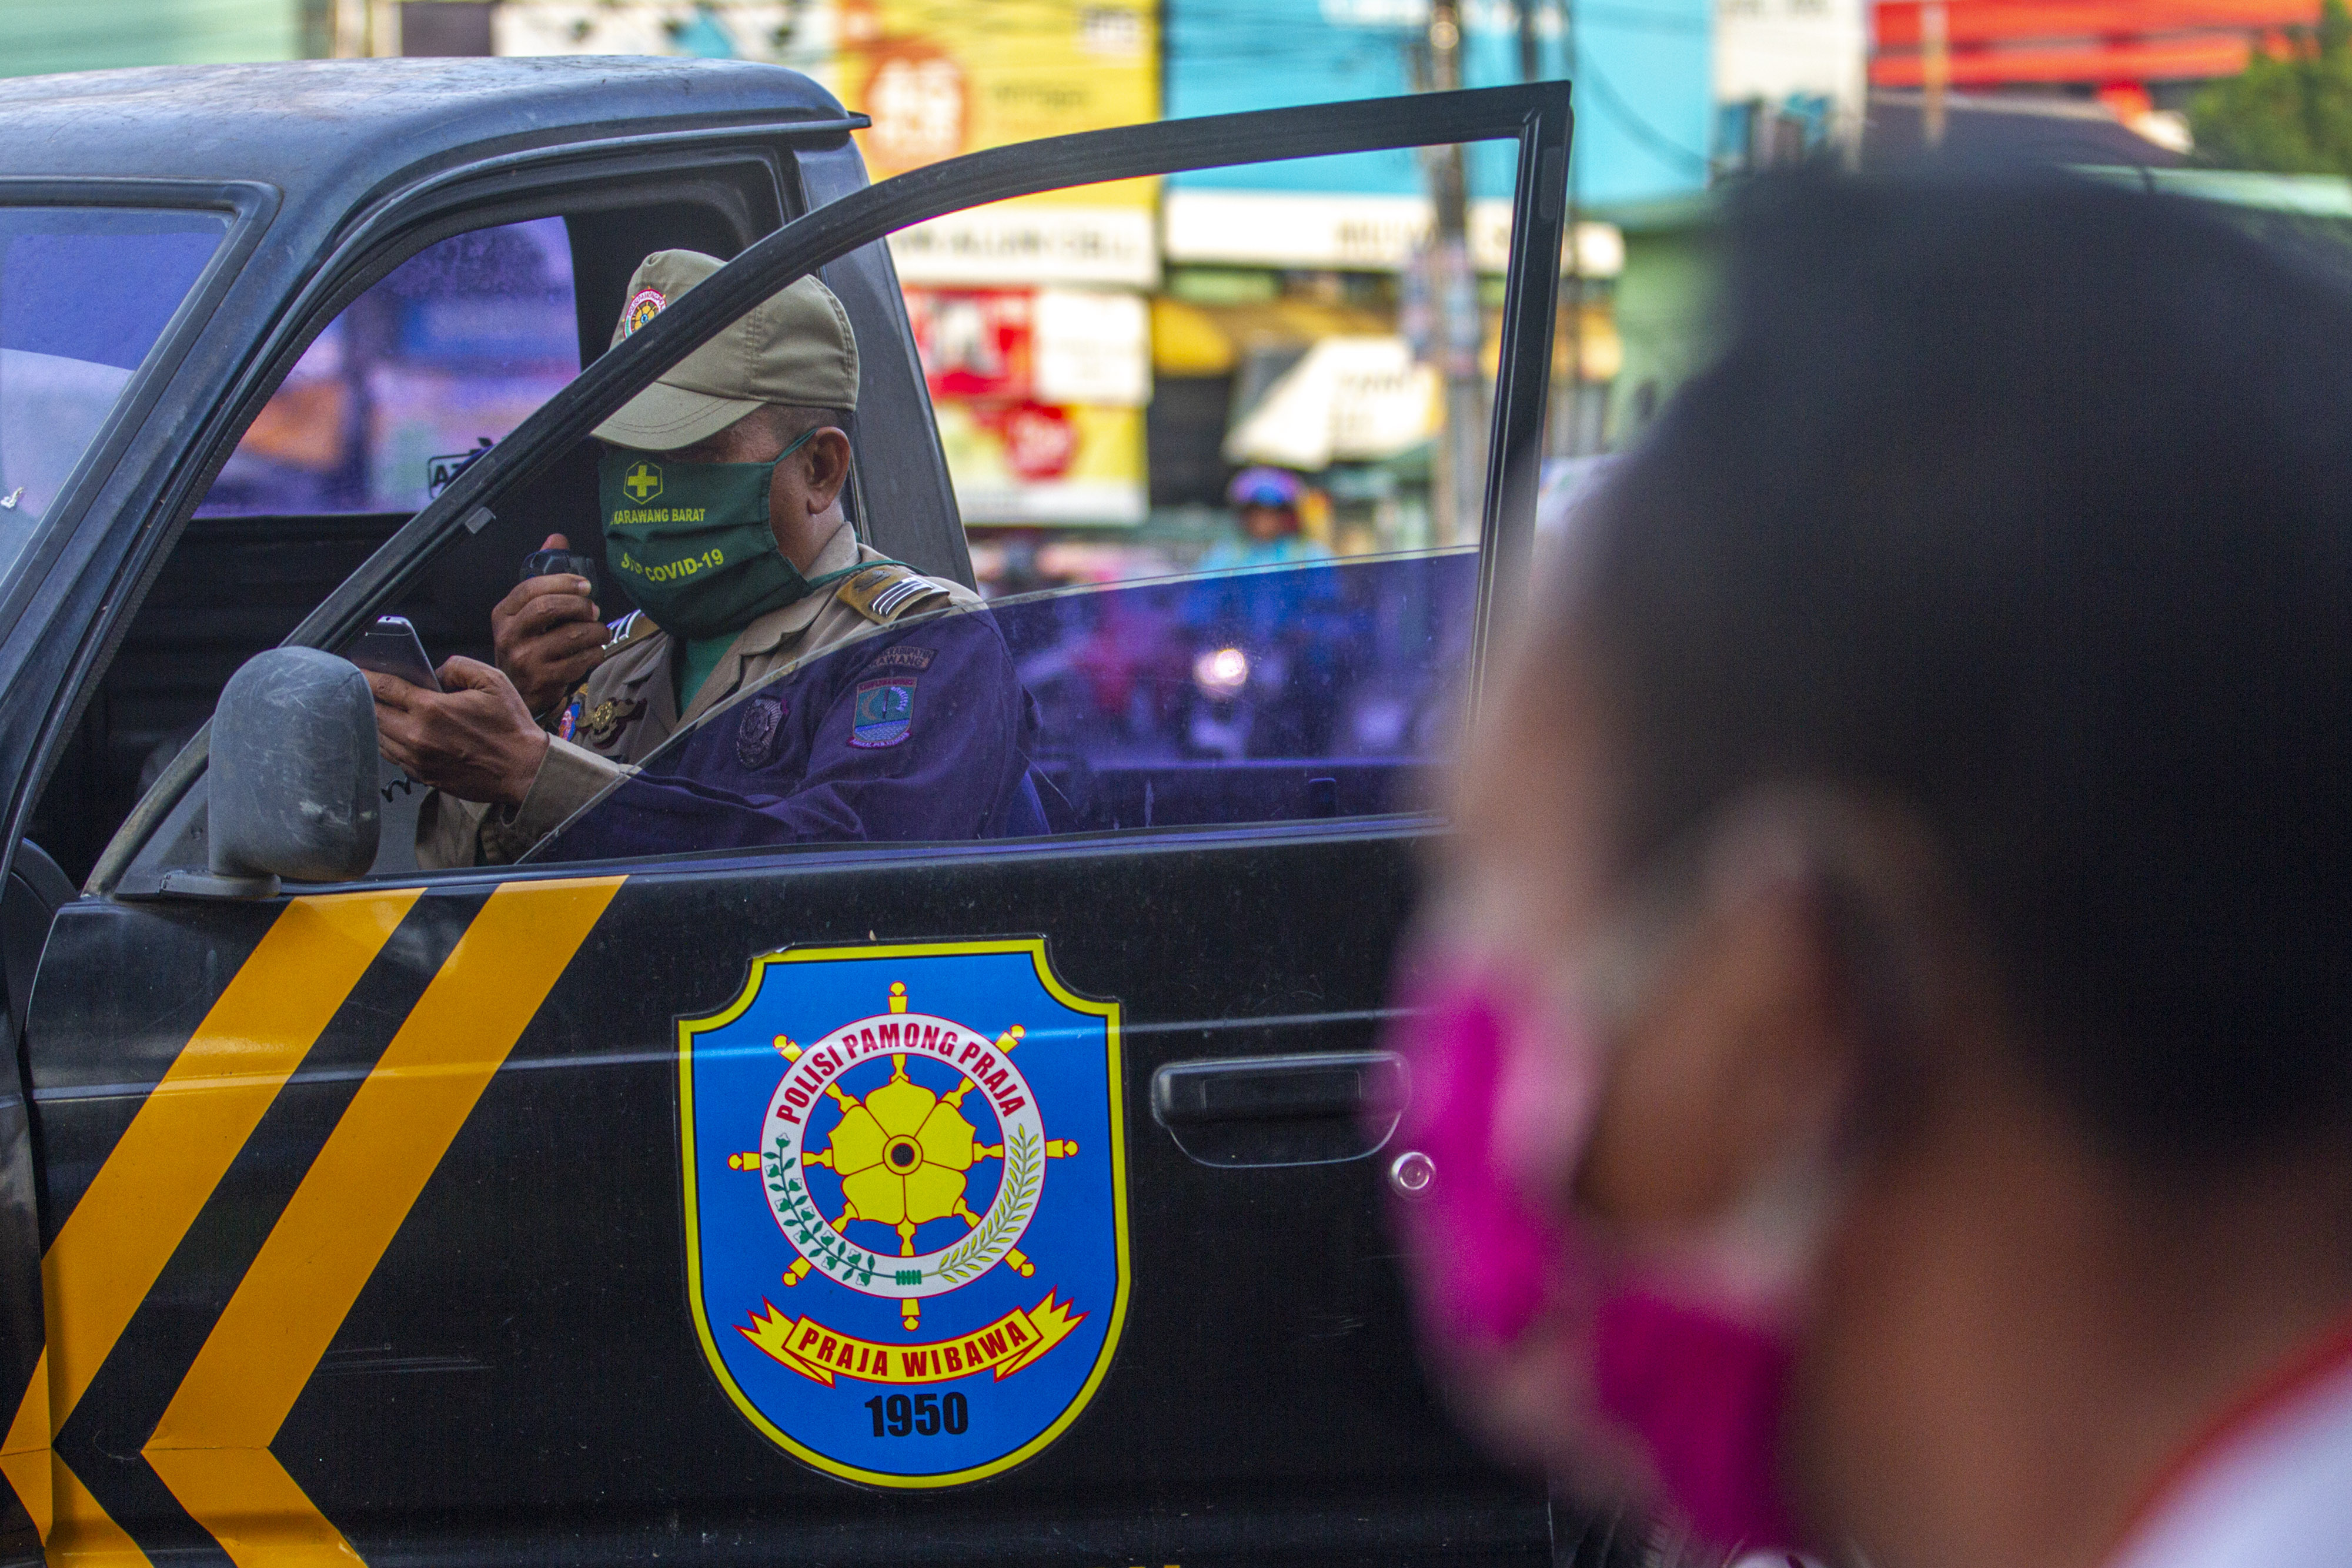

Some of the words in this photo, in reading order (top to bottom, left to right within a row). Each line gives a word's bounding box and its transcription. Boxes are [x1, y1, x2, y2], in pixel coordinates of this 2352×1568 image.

[671, 508, 706, 522] BARAT
[621, 552, 643, 574] STO
[644, 549, 724, 582] COVID-19
[776, 1045, 844, 1125] POLISI
[841, 1022, 958, 1059] PAMONG
[957, 1042, 1026, 1118] PRAJA
[798, 1327, 887, 1376] PRAJA
[901, 1320, 1029, 1378] WIBAWA
[864, 1391, 969, 1437] 1950
